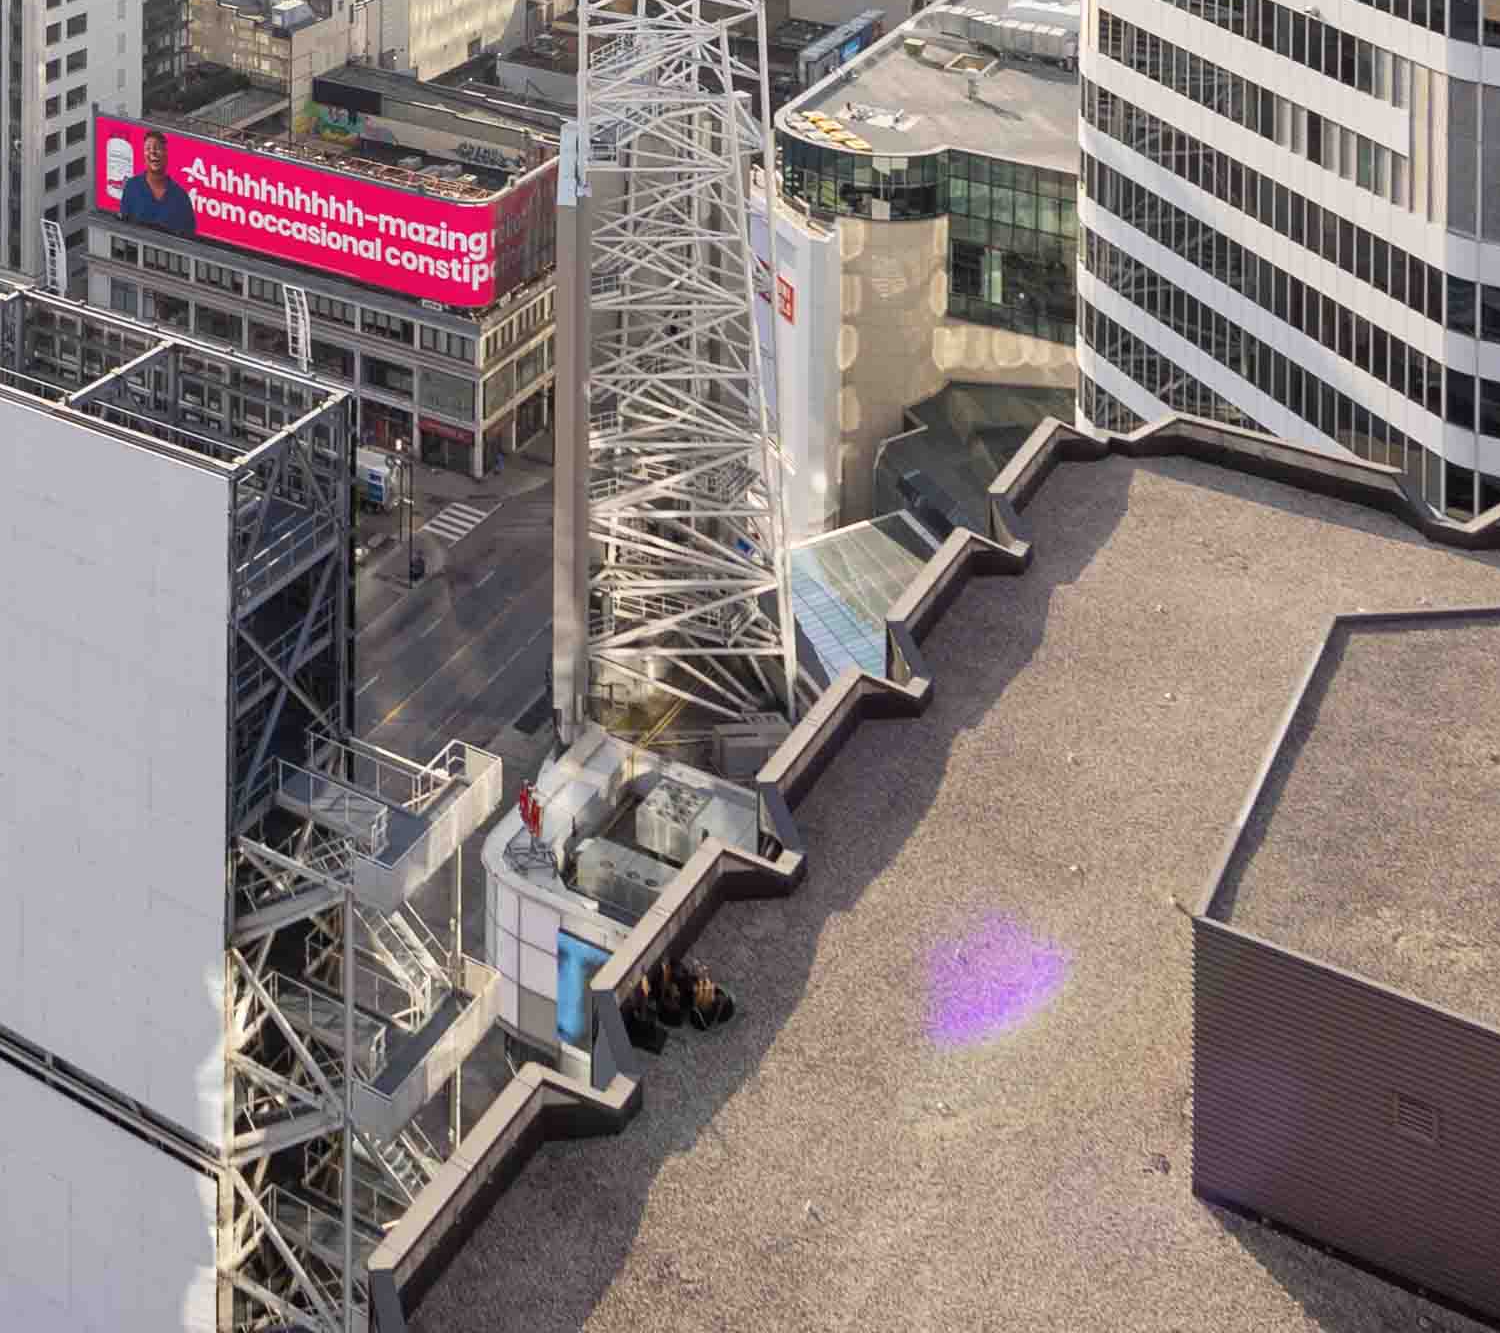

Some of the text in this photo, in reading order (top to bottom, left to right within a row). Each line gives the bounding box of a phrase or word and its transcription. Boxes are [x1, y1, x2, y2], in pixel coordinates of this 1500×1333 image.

[189, 187, 496, 292] from occasional constip
